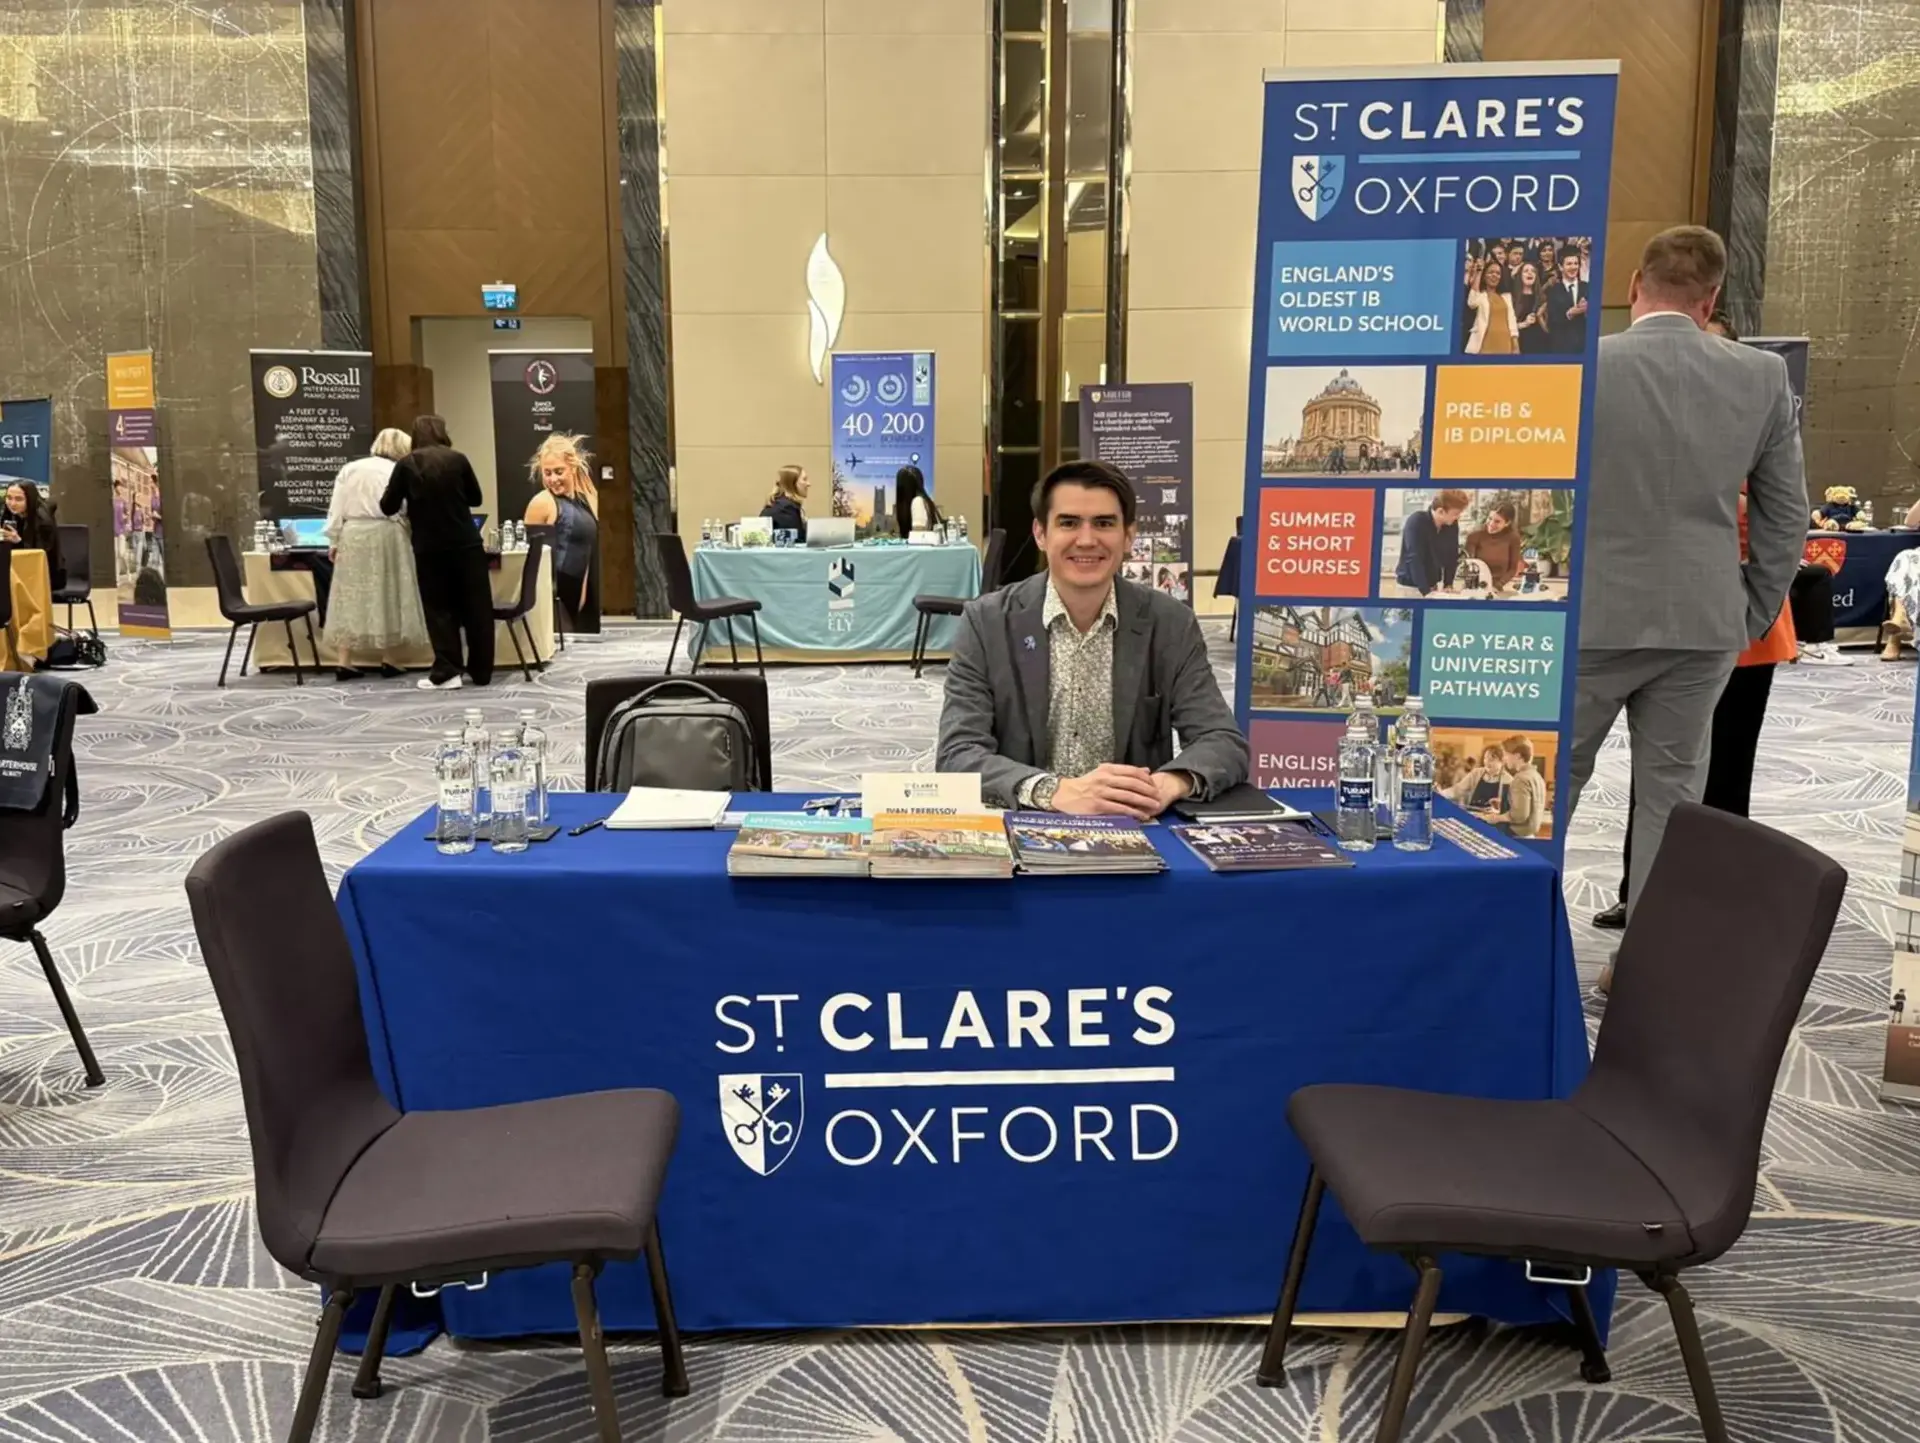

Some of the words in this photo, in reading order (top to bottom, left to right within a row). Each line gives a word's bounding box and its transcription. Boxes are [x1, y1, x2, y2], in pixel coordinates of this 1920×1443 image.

[1358, 97, 1584, 140] CLARE'S
[1354, 174, 1580, 215] OXFORD
[1281, 265, 1394, 284] ENGLAND'S
[1279, 291, 1356, 308] OLDEST
[1361, 290, 1380, 307] IB
[1279, 315, 1353, 332] WORLD
[1358, 314, 1444, 331] SCHOOL
[300, 366, 361, 386] Rossall
[296, 407, 316, 415] FLEET
[1446, 402, 1512, 418] PRE-IB
[1518, 402, 1533, 418] &
[115, 414, 124, 436] 4
[840, 412, 874, 436] 40
[880, 412, 924, 434] 200
[1, 434, 41, 449] GIFT
[288, 440, 317, 448] GRAND
[318, 440, 343, 448] PIANO
[1445, 427, 1463, 443] IB
[1470, 427, 1566, 443] DIPLOMA
[1269, 511, 1356, 528] SUMMER
[1268, 536, 1280, 551] &
[1287, 536, 1354, 552] SHORT
[1267, 558, 1361, 576] COURSES
[828, 618, 853, 632] ELY
[1432, 633, 1475, 650] GAP
[1481, 633, 1534, 651] YEAR
[1540, 636, 1554, 651] &
[1431, 656, 1553, 676] UNIVERSITY
[1430, 680, 1540, 698] PATHWAYS
[1342, 786, 1370, 794] TURAN
[819, 986, 1176, 1052] CLARE'S
[824, 1103, 1179, 1166] OXFORD
